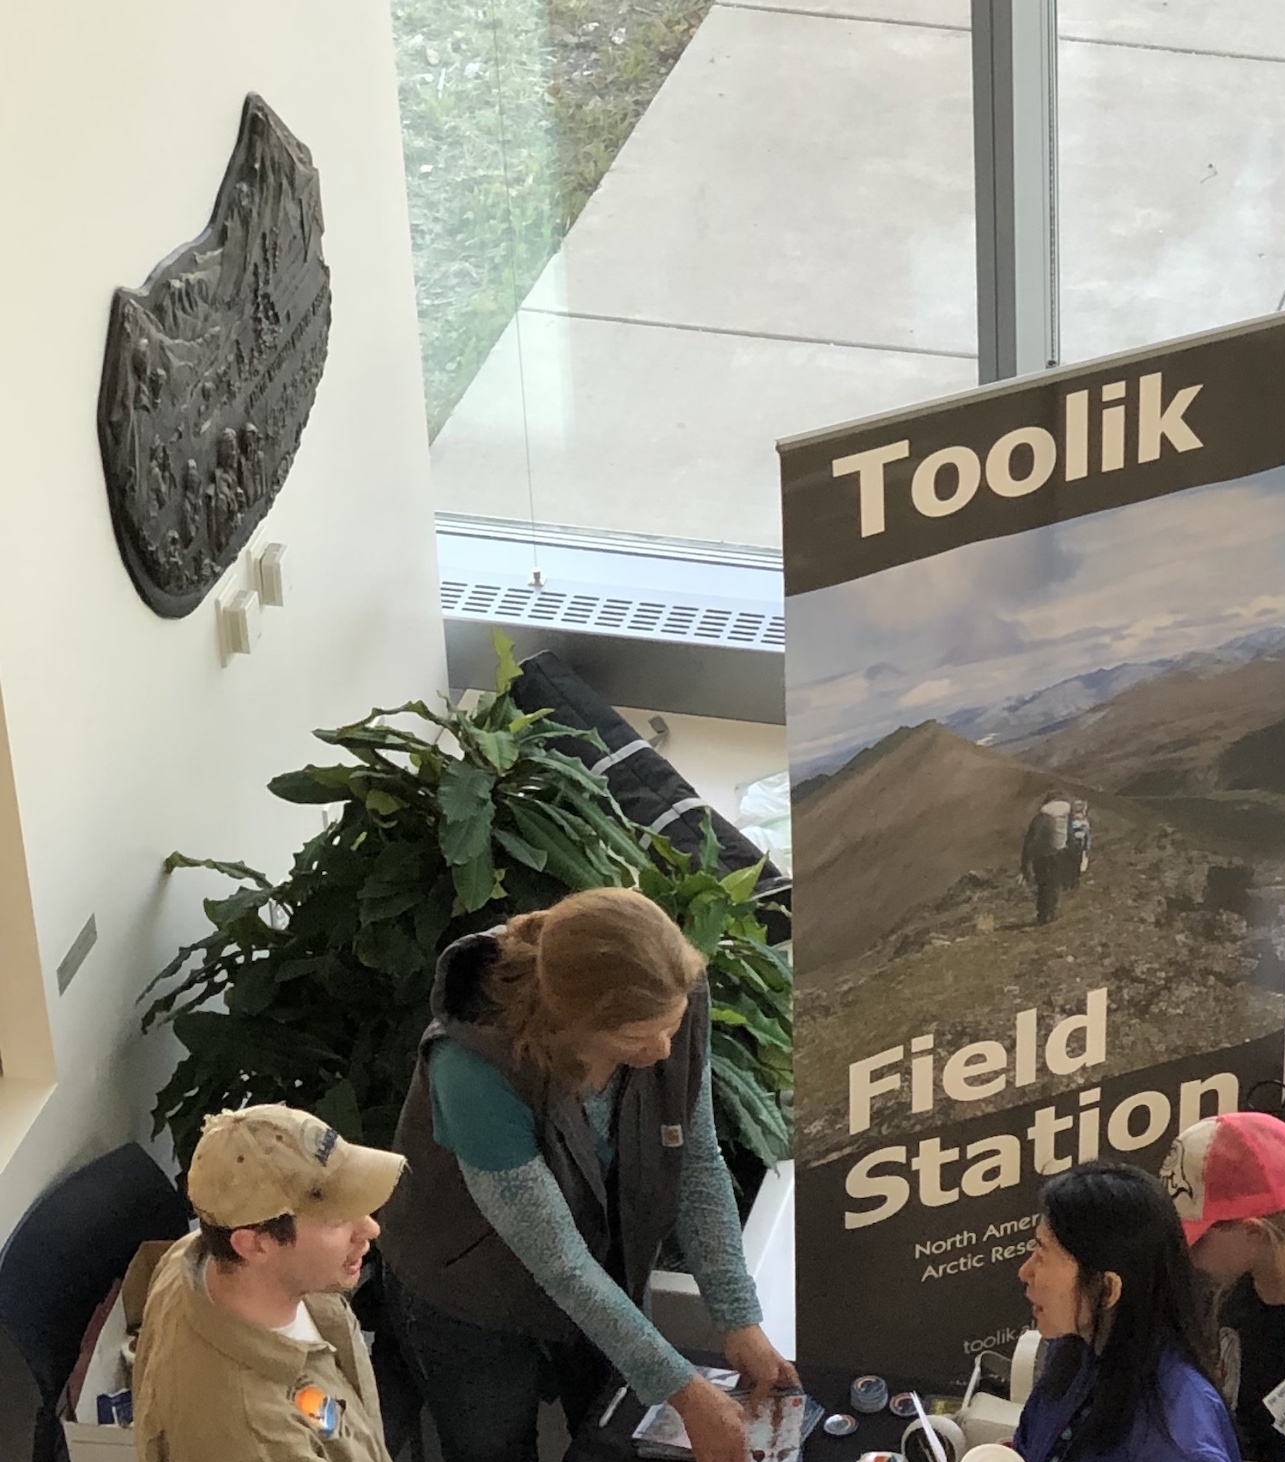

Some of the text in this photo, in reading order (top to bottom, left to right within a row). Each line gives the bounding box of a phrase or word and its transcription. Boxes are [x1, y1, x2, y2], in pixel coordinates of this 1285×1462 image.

[832, 371, 1204, 538] Toolik
[849, 987, 1108, 1135] Field
[844, 1072, 1240, 1230] Station
[915, 1213, 1040, 1259] North Amer
[921, 1238, 1037, 1282] Arctic Rese
[963, 1319, 1036, 1354] toolik.al
